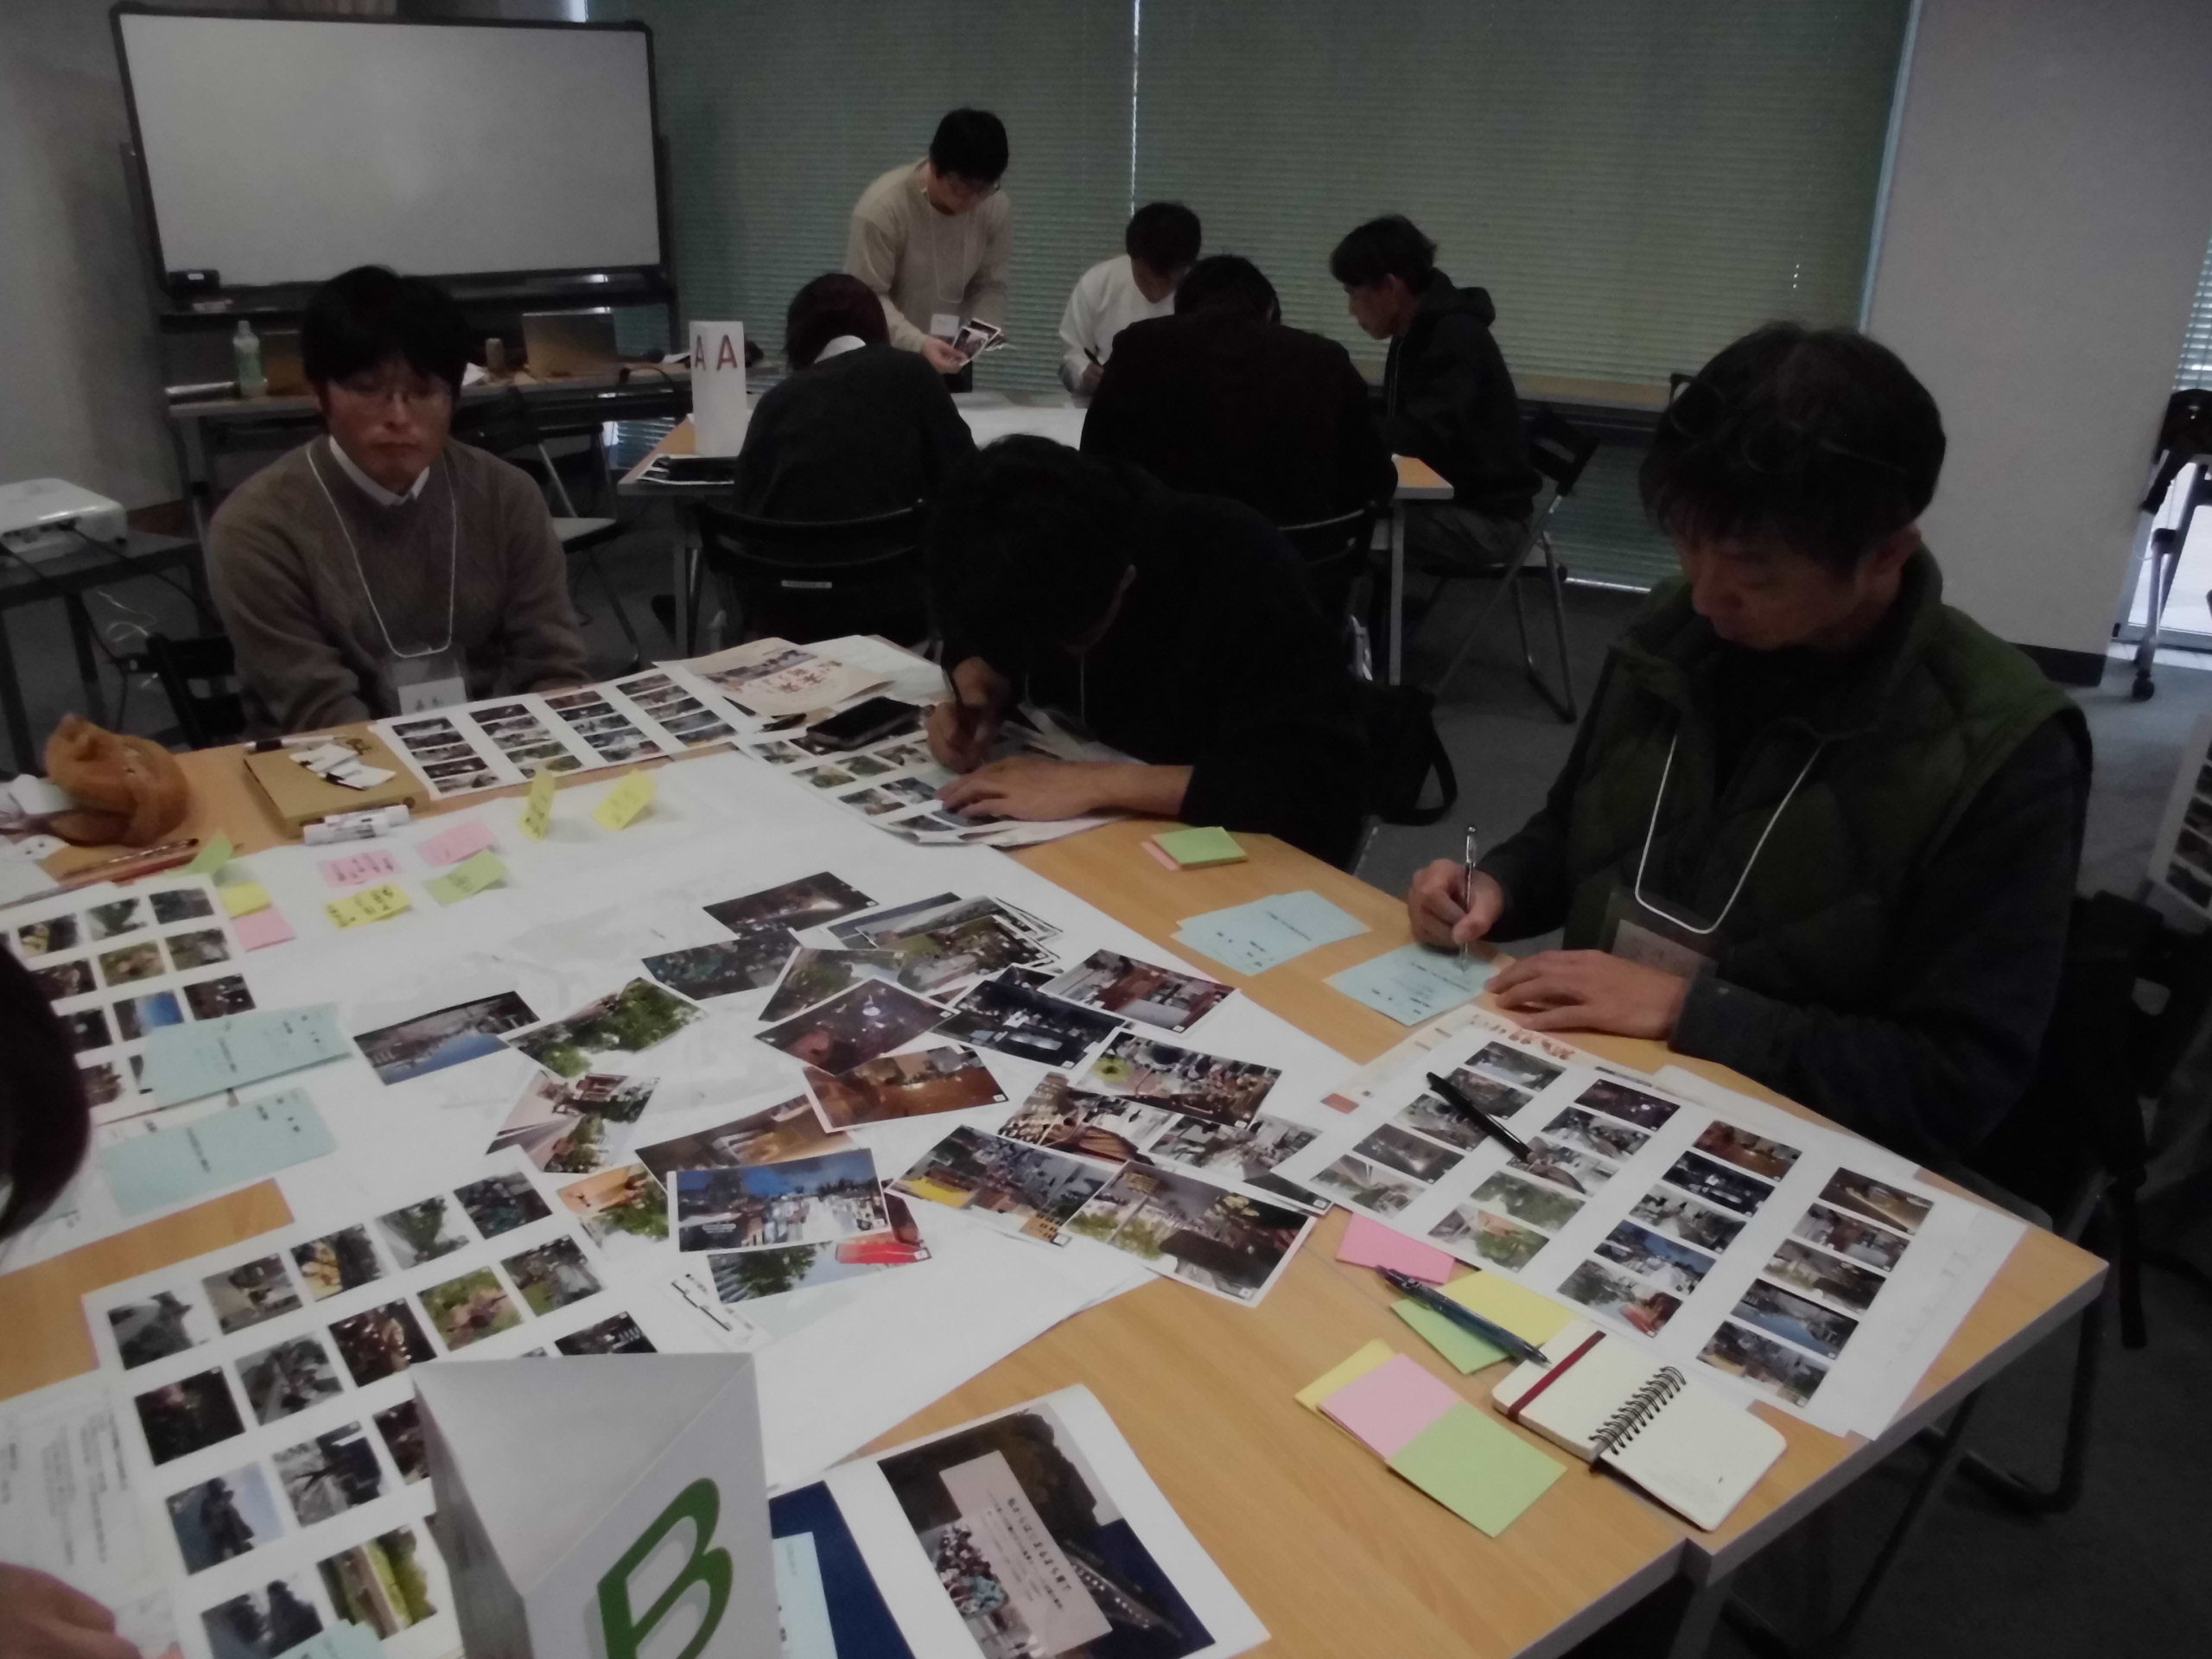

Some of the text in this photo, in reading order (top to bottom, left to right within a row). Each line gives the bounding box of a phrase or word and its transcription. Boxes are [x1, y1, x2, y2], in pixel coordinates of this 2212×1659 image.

[695, 334, 706, 372] A
[716, 334, 738, 372] A
[597, 1478, 733, 1659] B
